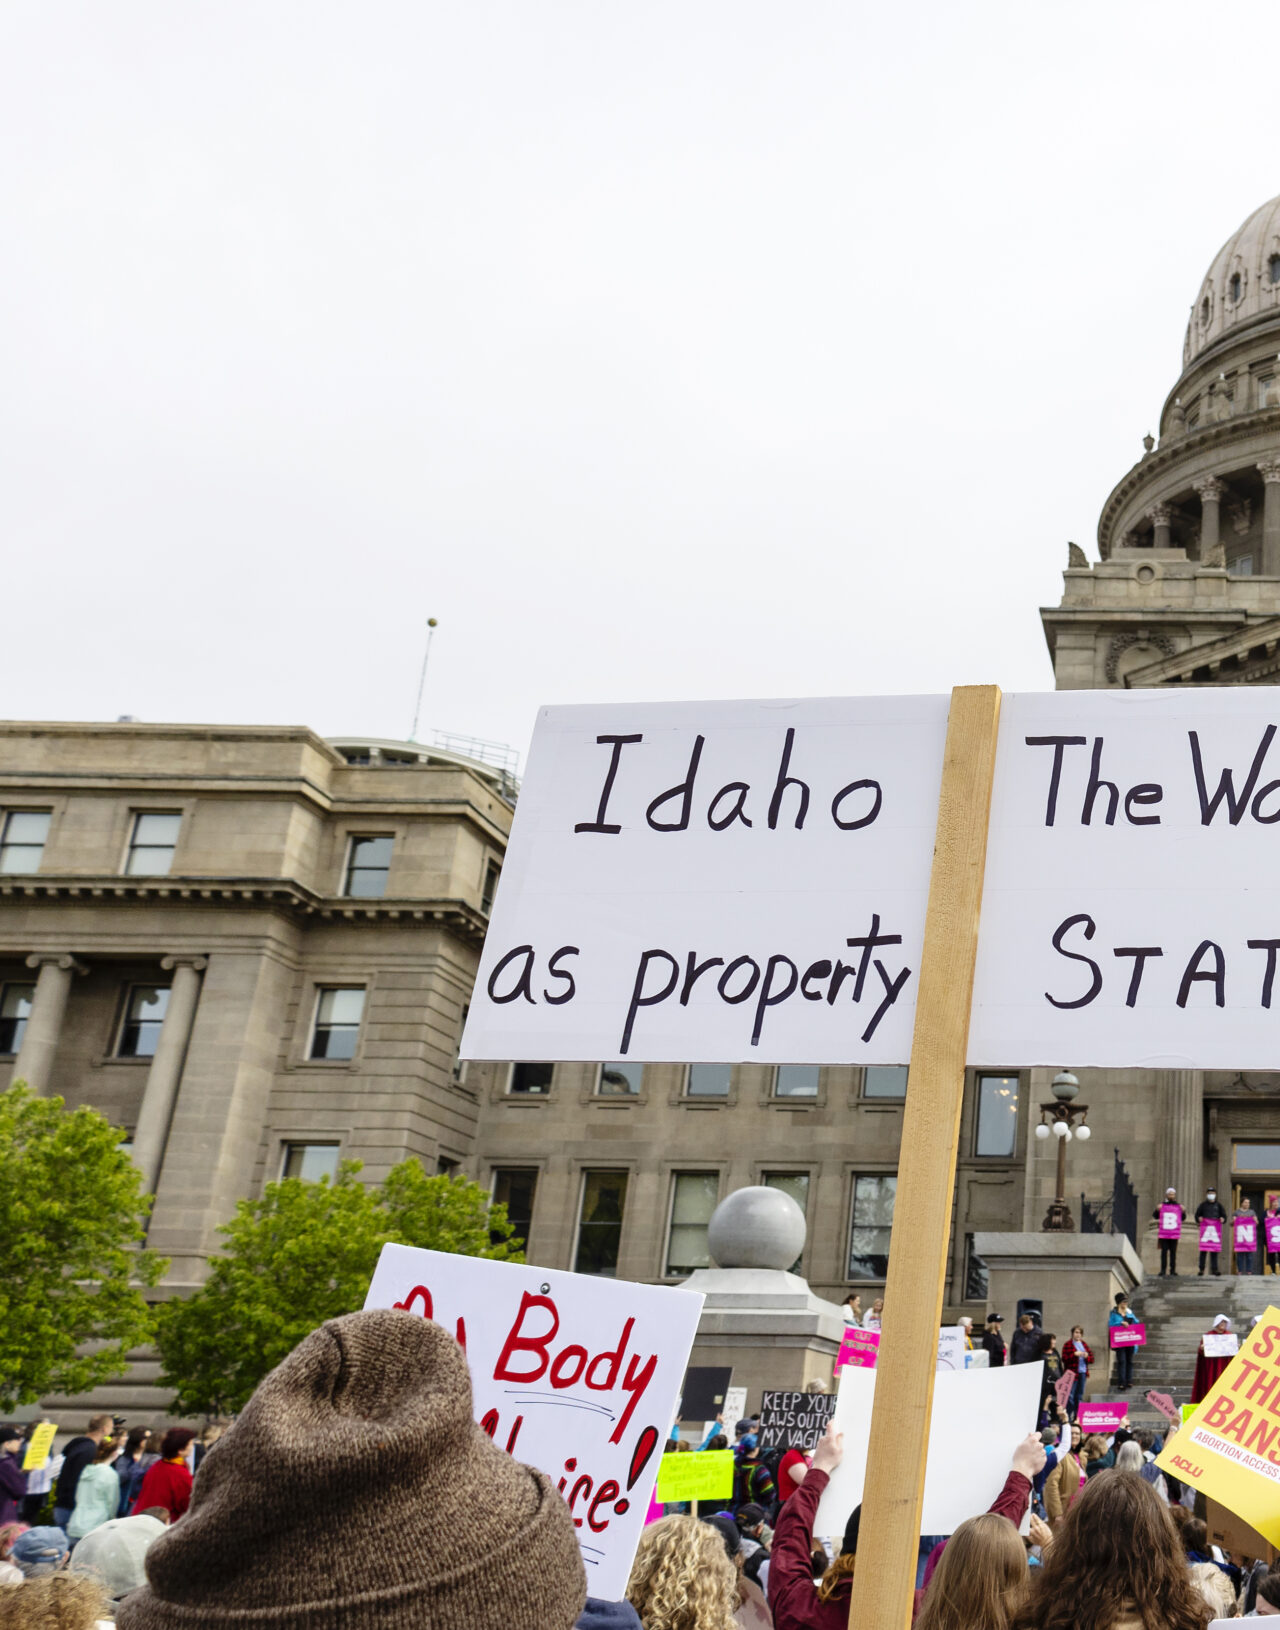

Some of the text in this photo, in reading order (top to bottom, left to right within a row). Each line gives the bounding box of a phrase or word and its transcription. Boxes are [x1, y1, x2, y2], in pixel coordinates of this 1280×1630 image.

[574, 727, 883, 835] Idaho
[1025, 736, 1163, 827] The
[487, 944, 580, 1005] as
[619, 914, 912, 1055] property
[493, 1290, 658, 1445] Body
[760, 1411, 796, 1427] LAWS
[763, 1392, 802, 1411] KEEP
[760, 1427, 827, 1449] MY VAGI
[1195, 1431, 1243, 1461] ABORTION
[1241, 1454, 1280, 1478] ACCESS
[1169, 1454, 1204, 1479] ACLU
